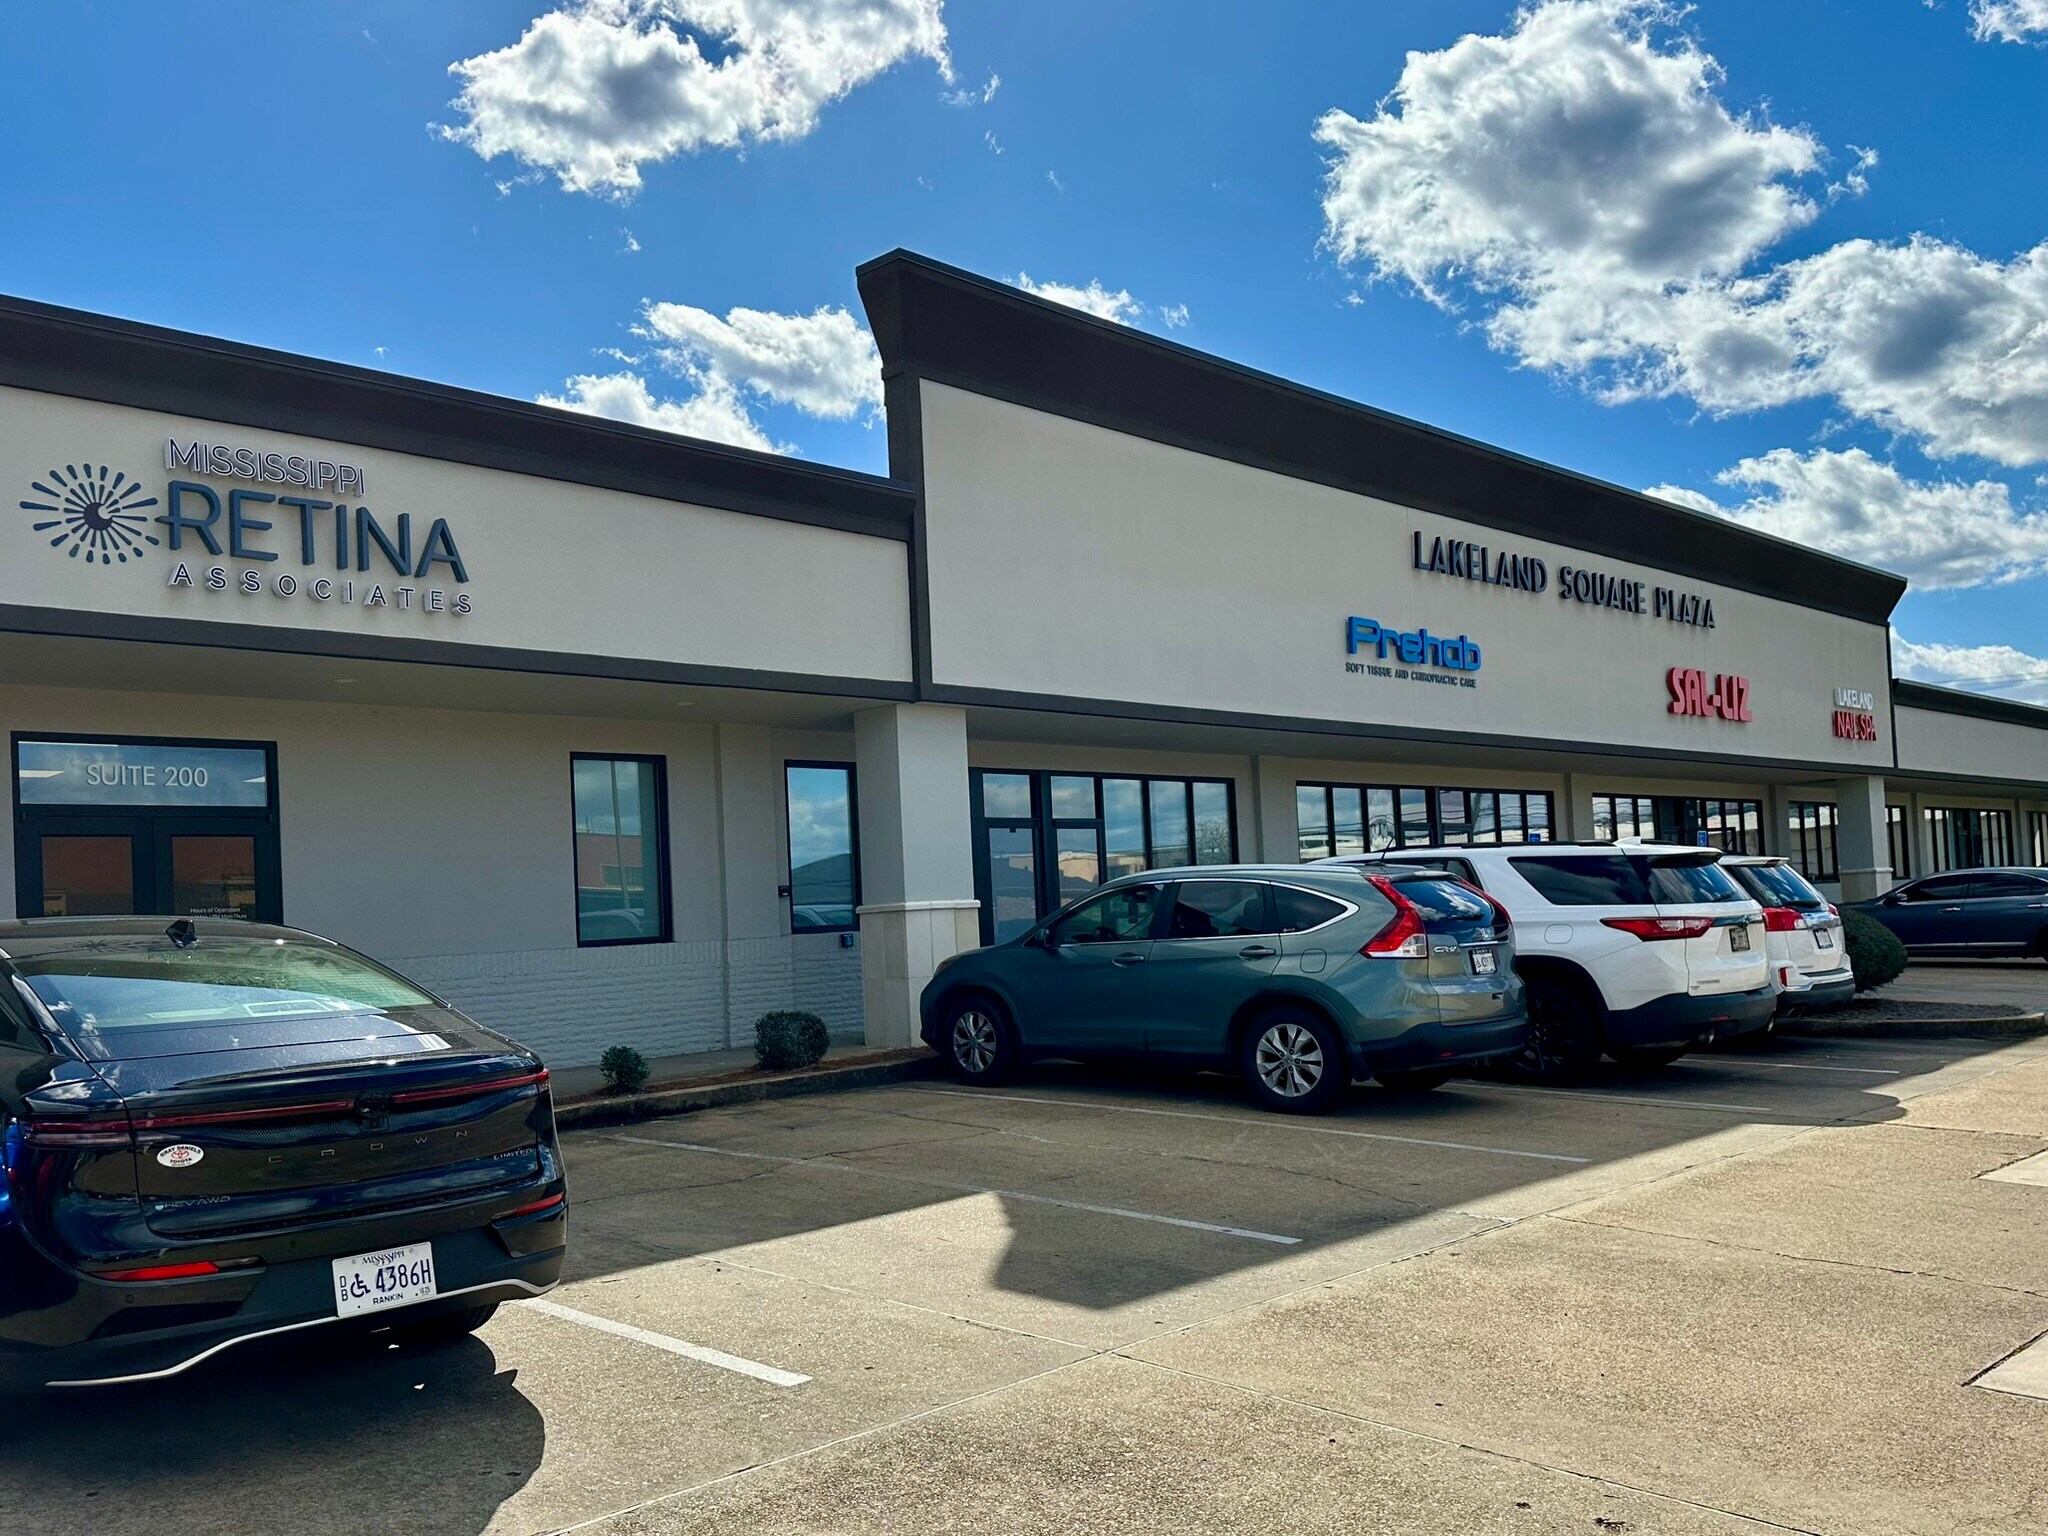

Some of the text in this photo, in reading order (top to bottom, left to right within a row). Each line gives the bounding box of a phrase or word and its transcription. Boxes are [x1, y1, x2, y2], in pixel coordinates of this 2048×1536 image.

[165, 438, 365, 495] MISSISSIPPI
[156, 480, 468, 583] RETINA
[168, 562, 472, 615] ASSOCIATES
[1413, 531, 1715, 629] LAKELAND SQUARE PLAZA
[1347, 616, 1482, 671] Prehab
[1345, 662, 1365, 674] SOFT
[1367, 665, 1393, 678] TISSUE
[1395, 669, 1409, 680] AND
[1460, 677, 1477, 688] CARE
[1666, 667, 1752, 722] SAL-LIZ
[1835, 687, 1874, 711] LAKELAND
[1833, 710, 1877, 741] NAIL SPA
[86, 764, 209, 788] SUITE 200
[160, 1146, 201, 1157] GRAY DANIELS
[269, 1130, 468, 1163] CROWN
[493, 1148, 532, 1161] LIMITED
[197, 1195, 231, 1205] AWD
[362, 1250, 405, 1267] MISSISSIPPI
[376, 1258, 432, 1293] 4386H
[373, 1293, 404, 1305] RANKIN
